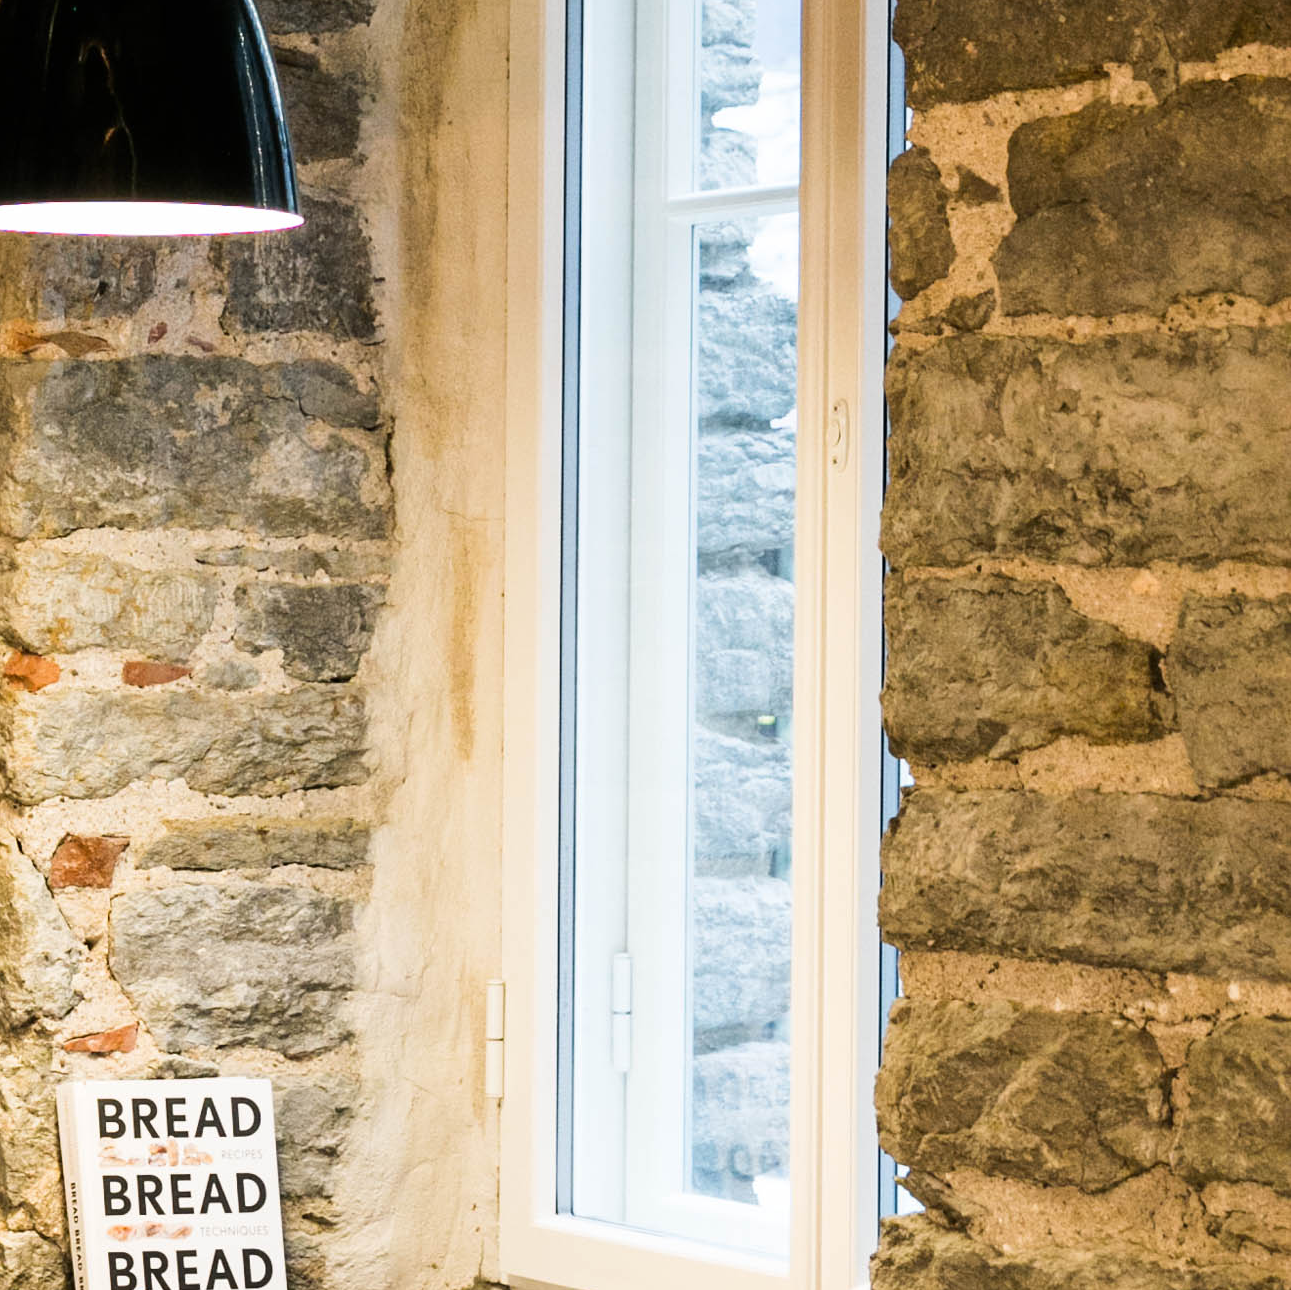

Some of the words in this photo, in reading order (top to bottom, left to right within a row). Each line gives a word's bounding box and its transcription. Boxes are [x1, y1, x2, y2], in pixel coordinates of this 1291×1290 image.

[97, 1097, 261, 1139] BREAD
[221, 1148, 262, 1160] RECIPES
[70, 1182, 79, 1224] BREAD
[102, 1173, 267, 1216] BREAD
[74, 1229, 83, 1271] BREAD
[200, 1225, 269, 1237] TECHNIQUES
